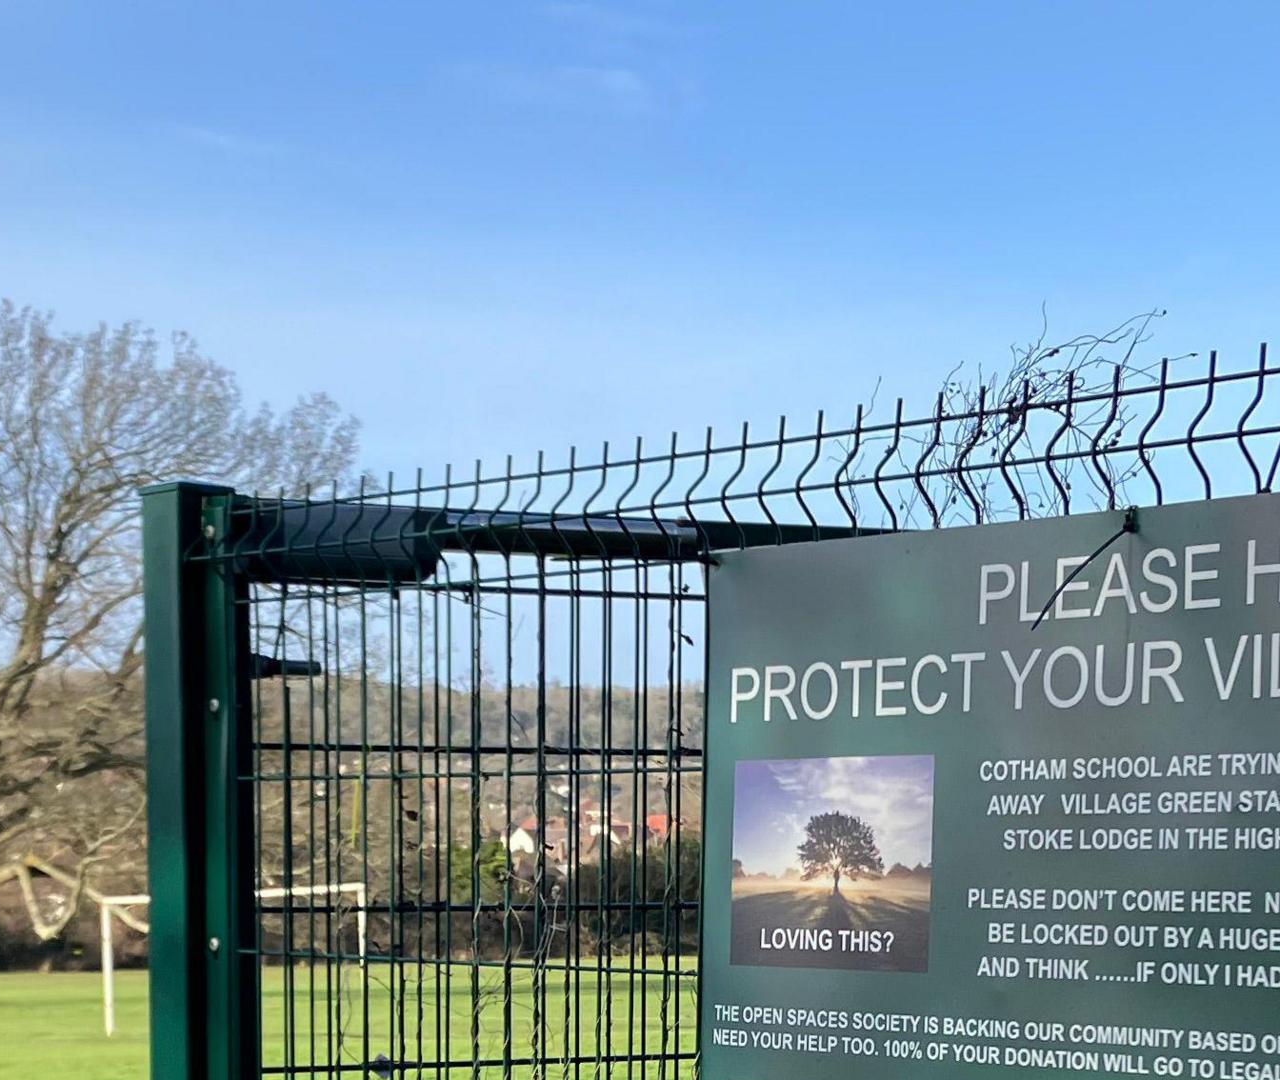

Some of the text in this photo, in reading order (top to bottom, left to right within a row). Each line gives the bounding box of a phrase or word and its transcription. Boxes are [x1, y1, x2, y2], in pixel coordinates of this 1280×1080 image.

[978, 543, 1221, 625] PLEASE
[730, 652, 986, 724] PROTECT
[1001, 638, 1185, 709] YOUR
[979, 758, 1067, 782] COTHAM
[1072, 756, 1163, 780] SCHOOL
[1166, 754, 1212, 777] ARE
[986, 794, 1046, 816] AWAY
[1060, 792, 1152, 815] VILLAGE
[1157, 791, 1233, 814] GREEN
[1003, 828, 1074, 851] STOKE
[1079, 828, 1154, 850] LODGE
[1158, 828, 1180, 850] IN
[1185, 827, 1229, 850] THE
[967, 888, 1047, 910] PLEASE
[1122, 889, 1185, 913] COME
[1191, 890, 1252, 914] HERE
[760, 928, 895, 953] LOVING THIS?
[988, 922, 1016, 944] BE
[1020, 923, 1109, 946] LOCKED
[1113, 925, 1159, 948] OUT
[1163, 926, 1194, 949] BY
[1197, 927, 1215, 949] A
[977, 956, 1020, 978] AND
[1024, 957, 1089, 981] THINK
[1160, 962, 1220, 986] ONLY
[1224, 964, 1231, 986] I
[714, 1004, 740, 1023] THE
[742, 1006, 783, 1025] OPEN
[786, 1008, 849, 1029] SPACES
[851, 1012, 922, 1033] SOCIETY
[923, 1015, 939, 1035] IS
[942, 1017, 1020, 1040] BACKING
[1024, 1021, 1065, 1042] OUR
[1069, 1024, 1185, 1049] COMMUNITY
[1188, 1030, 1257, 1053] BASED
[712, 1028, 748, 1047] NEED
[750, 1030, 793, 1051] YOUR
[796, 1033, 839, 1053] HELP
[841, 1036, 879, 1056] TOO.
[883, 1039, 923, 1060] 100%
[926, 1042, 950, 1061] OF
[952, 1043, 1001, 1065] YOUR
[1004, 1047, 1099, 1071] DONATION
[1103, 1053, 1150, 1075] WILL
[1153, 1056, 1184, 1077] GO
[1187, 1058, 1215, 1079] TO
